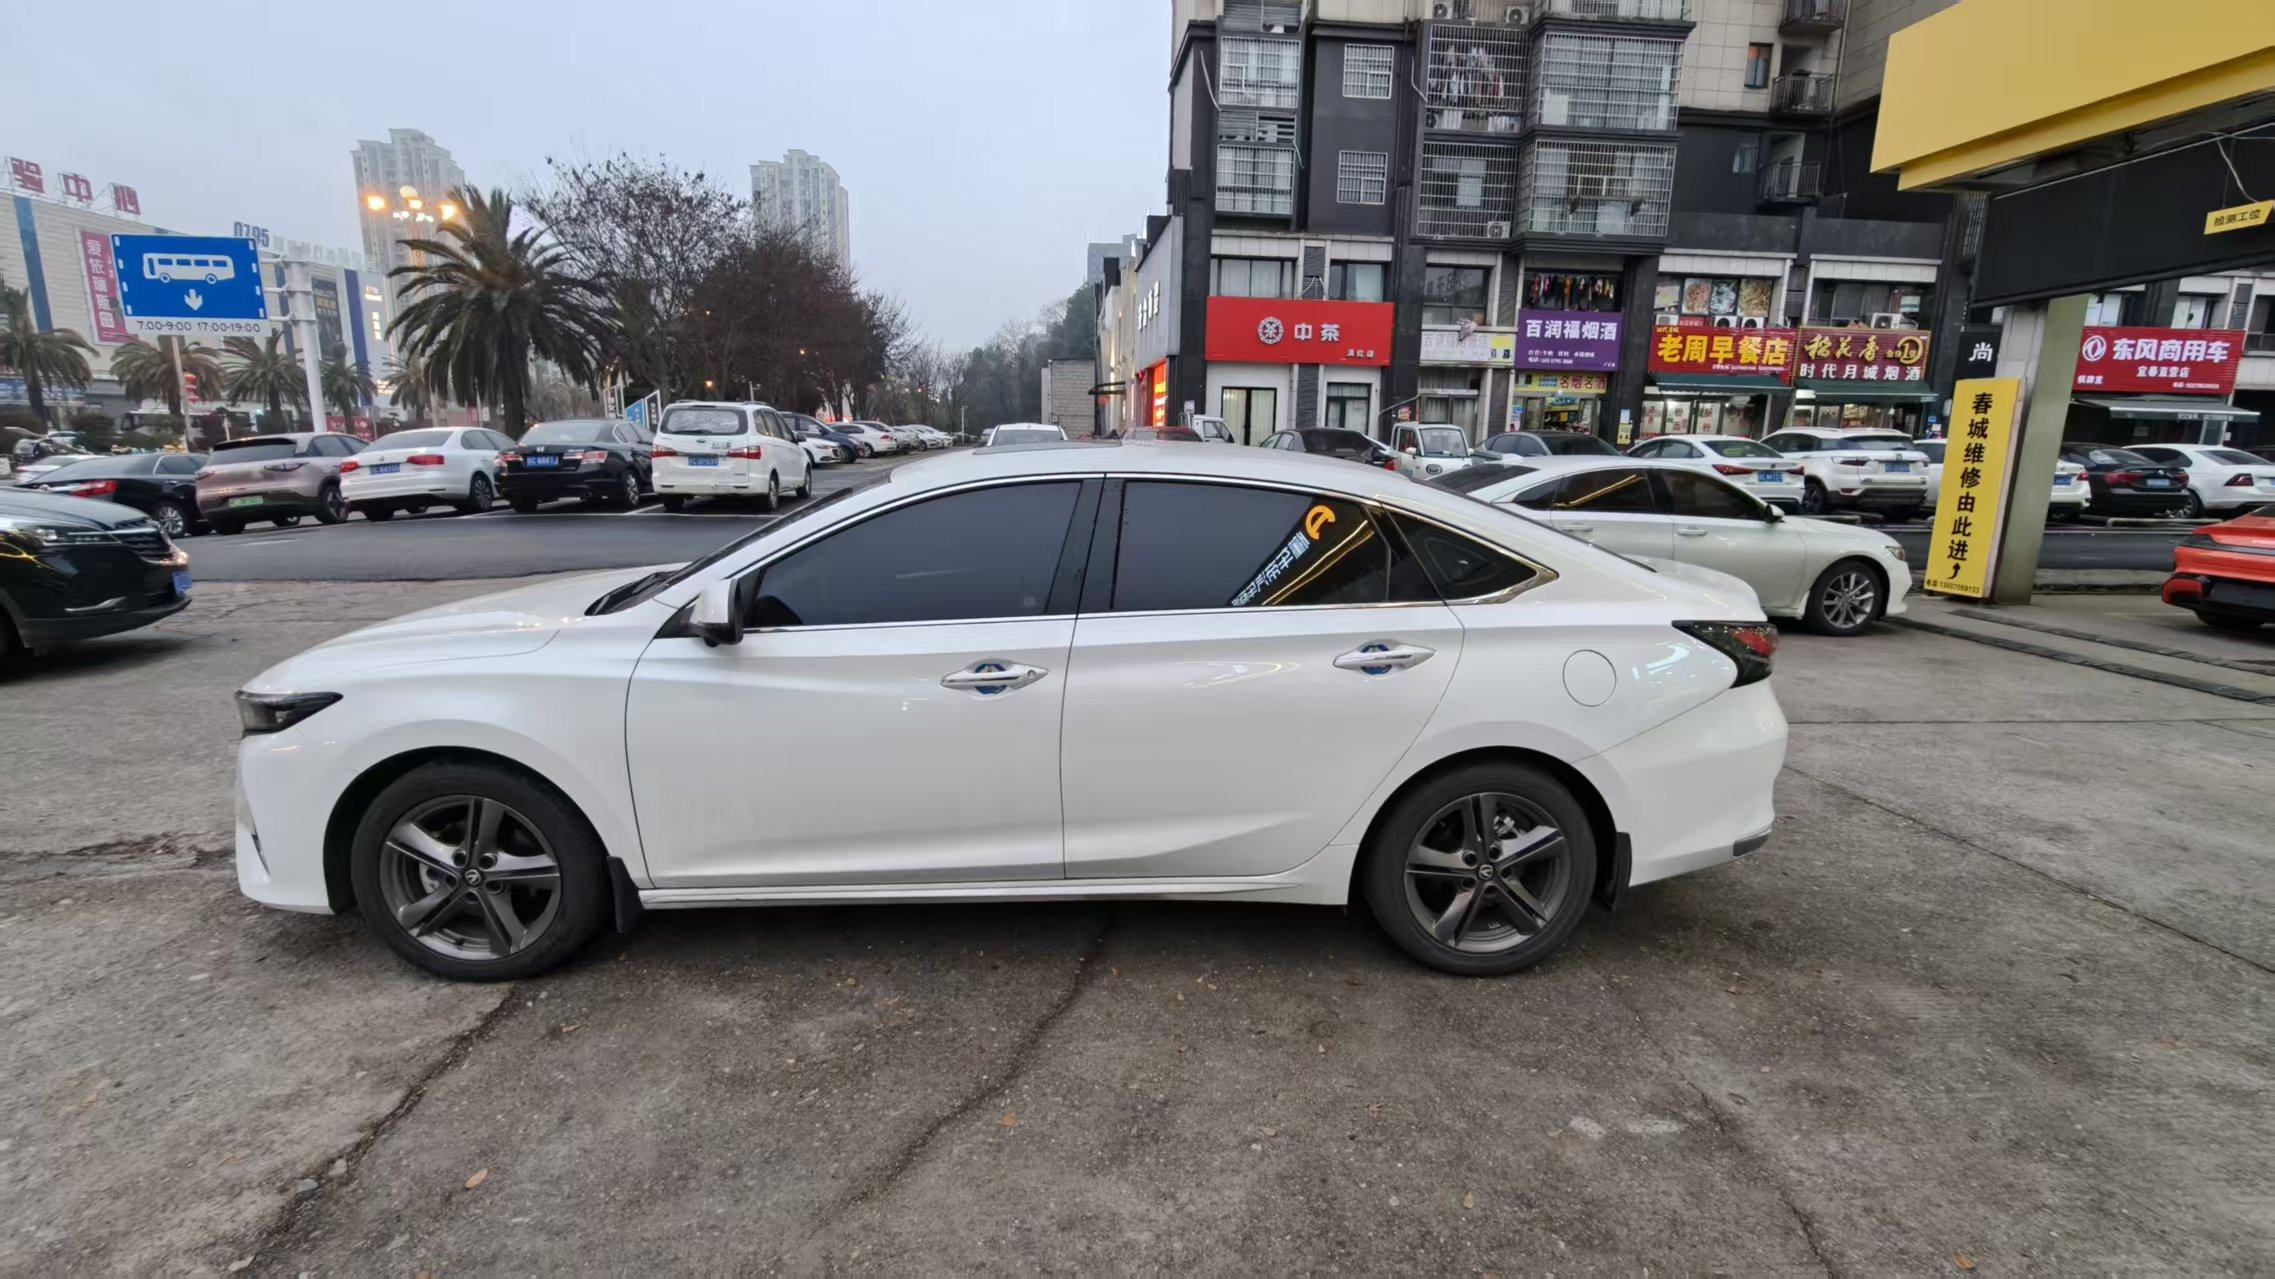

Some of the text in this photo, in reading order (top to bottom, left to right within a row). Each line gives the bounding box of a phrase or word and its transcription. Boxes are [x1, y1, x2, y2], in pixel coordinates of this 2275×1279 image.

[1294, 322, 1341, 342] 中茶
[1525, 319, 1618, 341] 百润福烟酒
[1657, 333, 1789, 365] 老周早餐店
[1968, 342, 1993, 362] 尚
[2112, 338, 2231, 363] 东风商用车
[1560, 375, 1606, 390] 名烟名酒
[1799, 363, 1921, 381] 时代月城烟酒
[1947, 392, 1993, 562] 春城维修由此进
